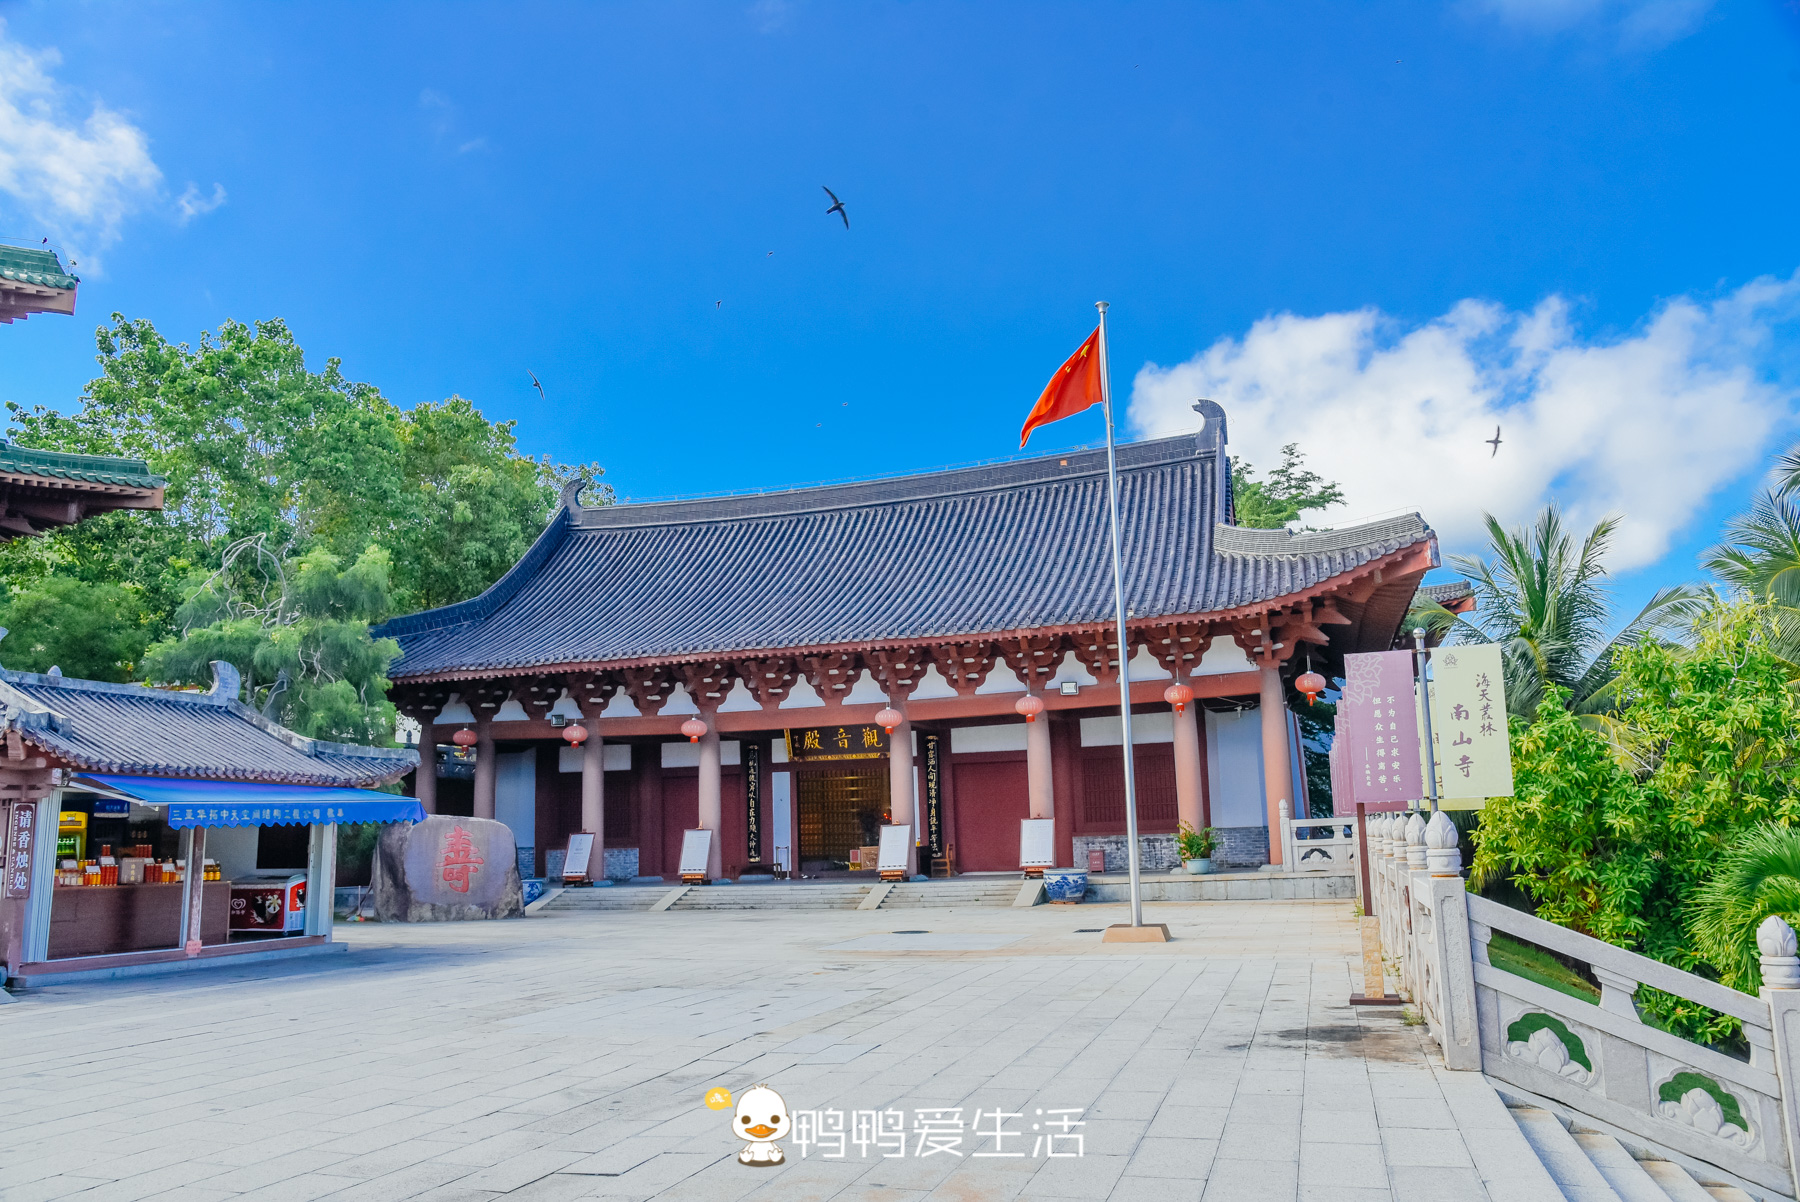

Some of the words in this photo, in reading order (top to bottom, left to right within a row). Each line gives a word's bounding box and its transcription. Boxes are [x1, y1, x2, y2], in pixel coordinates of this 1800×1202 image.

[1450, 703, 1474, 778] 南山寺
[14, 810, 32, 890] 请香烛处
